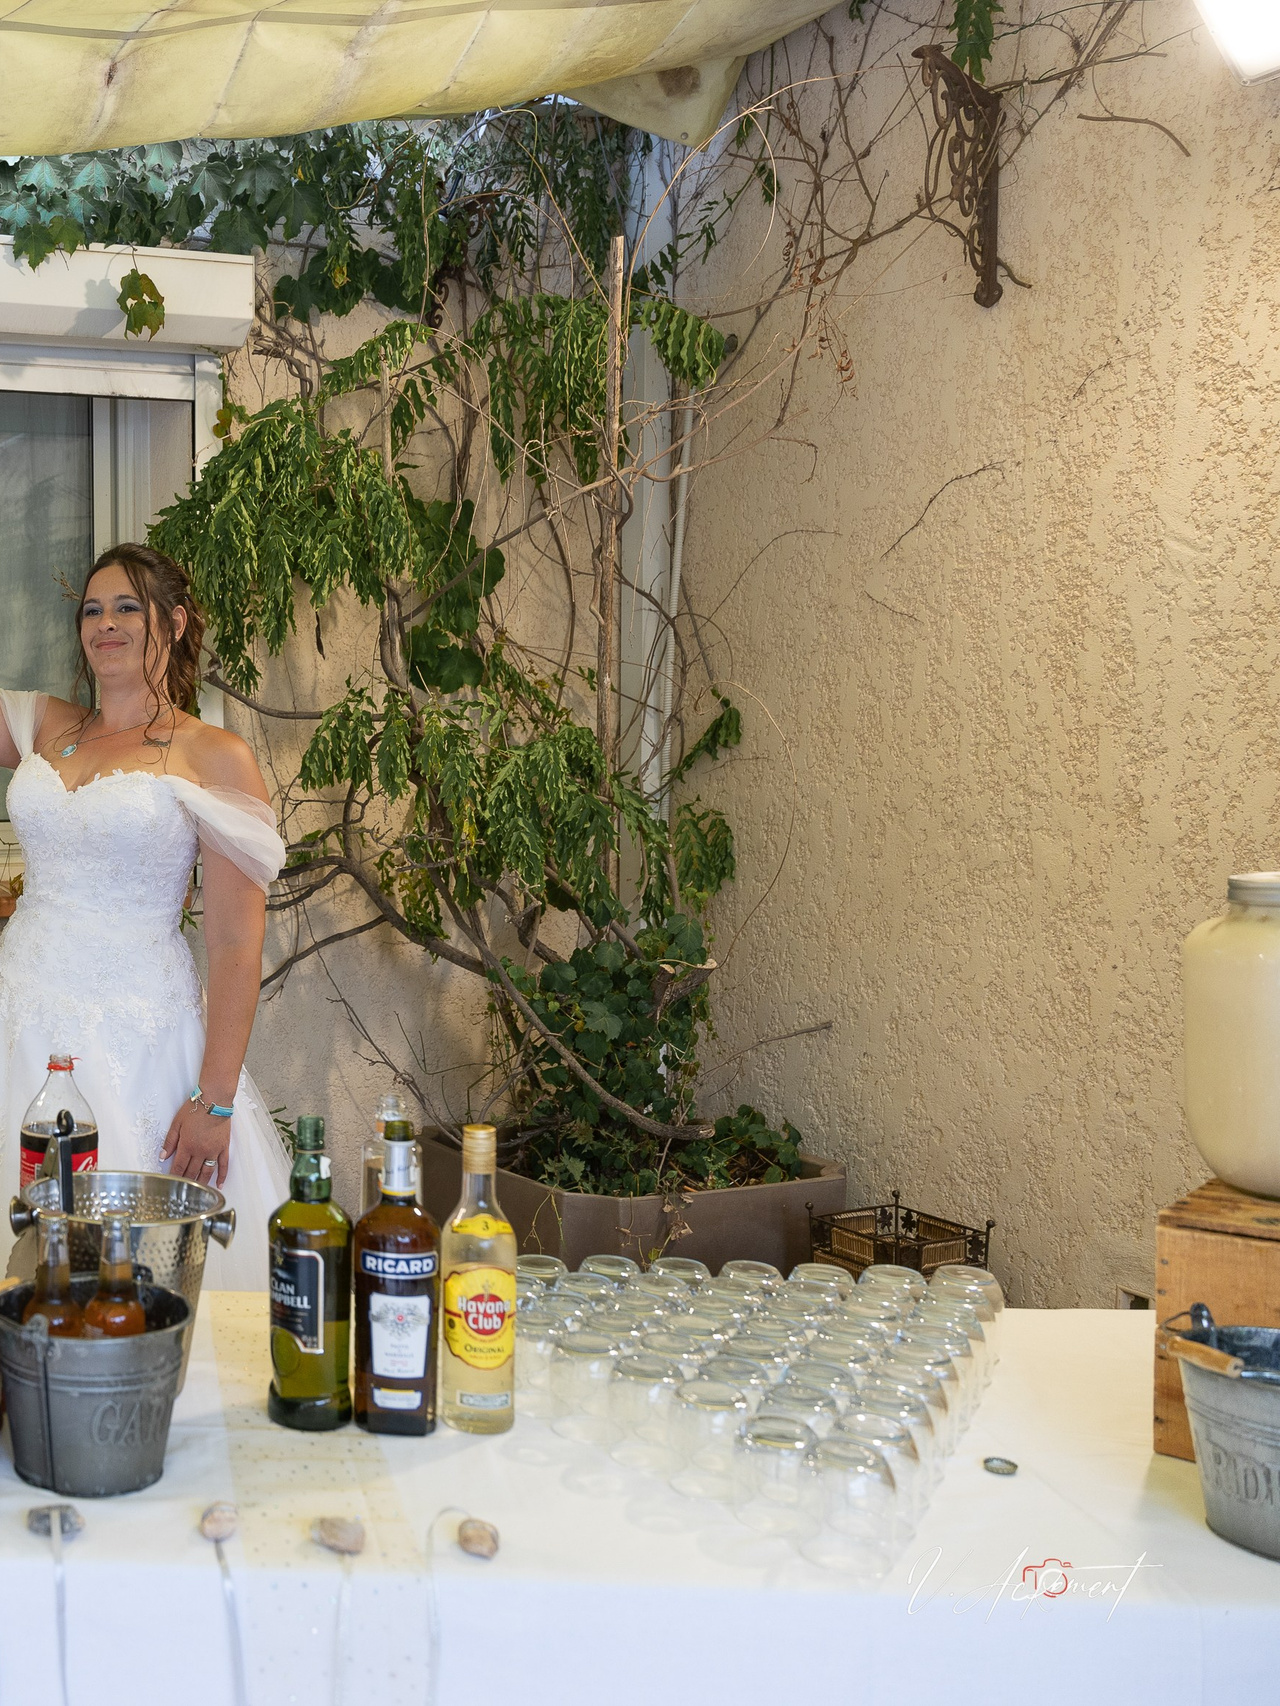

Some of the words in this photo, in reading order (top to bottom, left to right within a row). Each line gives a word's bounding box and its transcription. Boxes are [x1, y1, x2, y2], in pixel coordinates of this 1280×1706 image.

[365, 1255, 434, 1274] RICARD
[457, 1295, 511, 1313] Havana
[467, 1313, 502, 1330] Club
